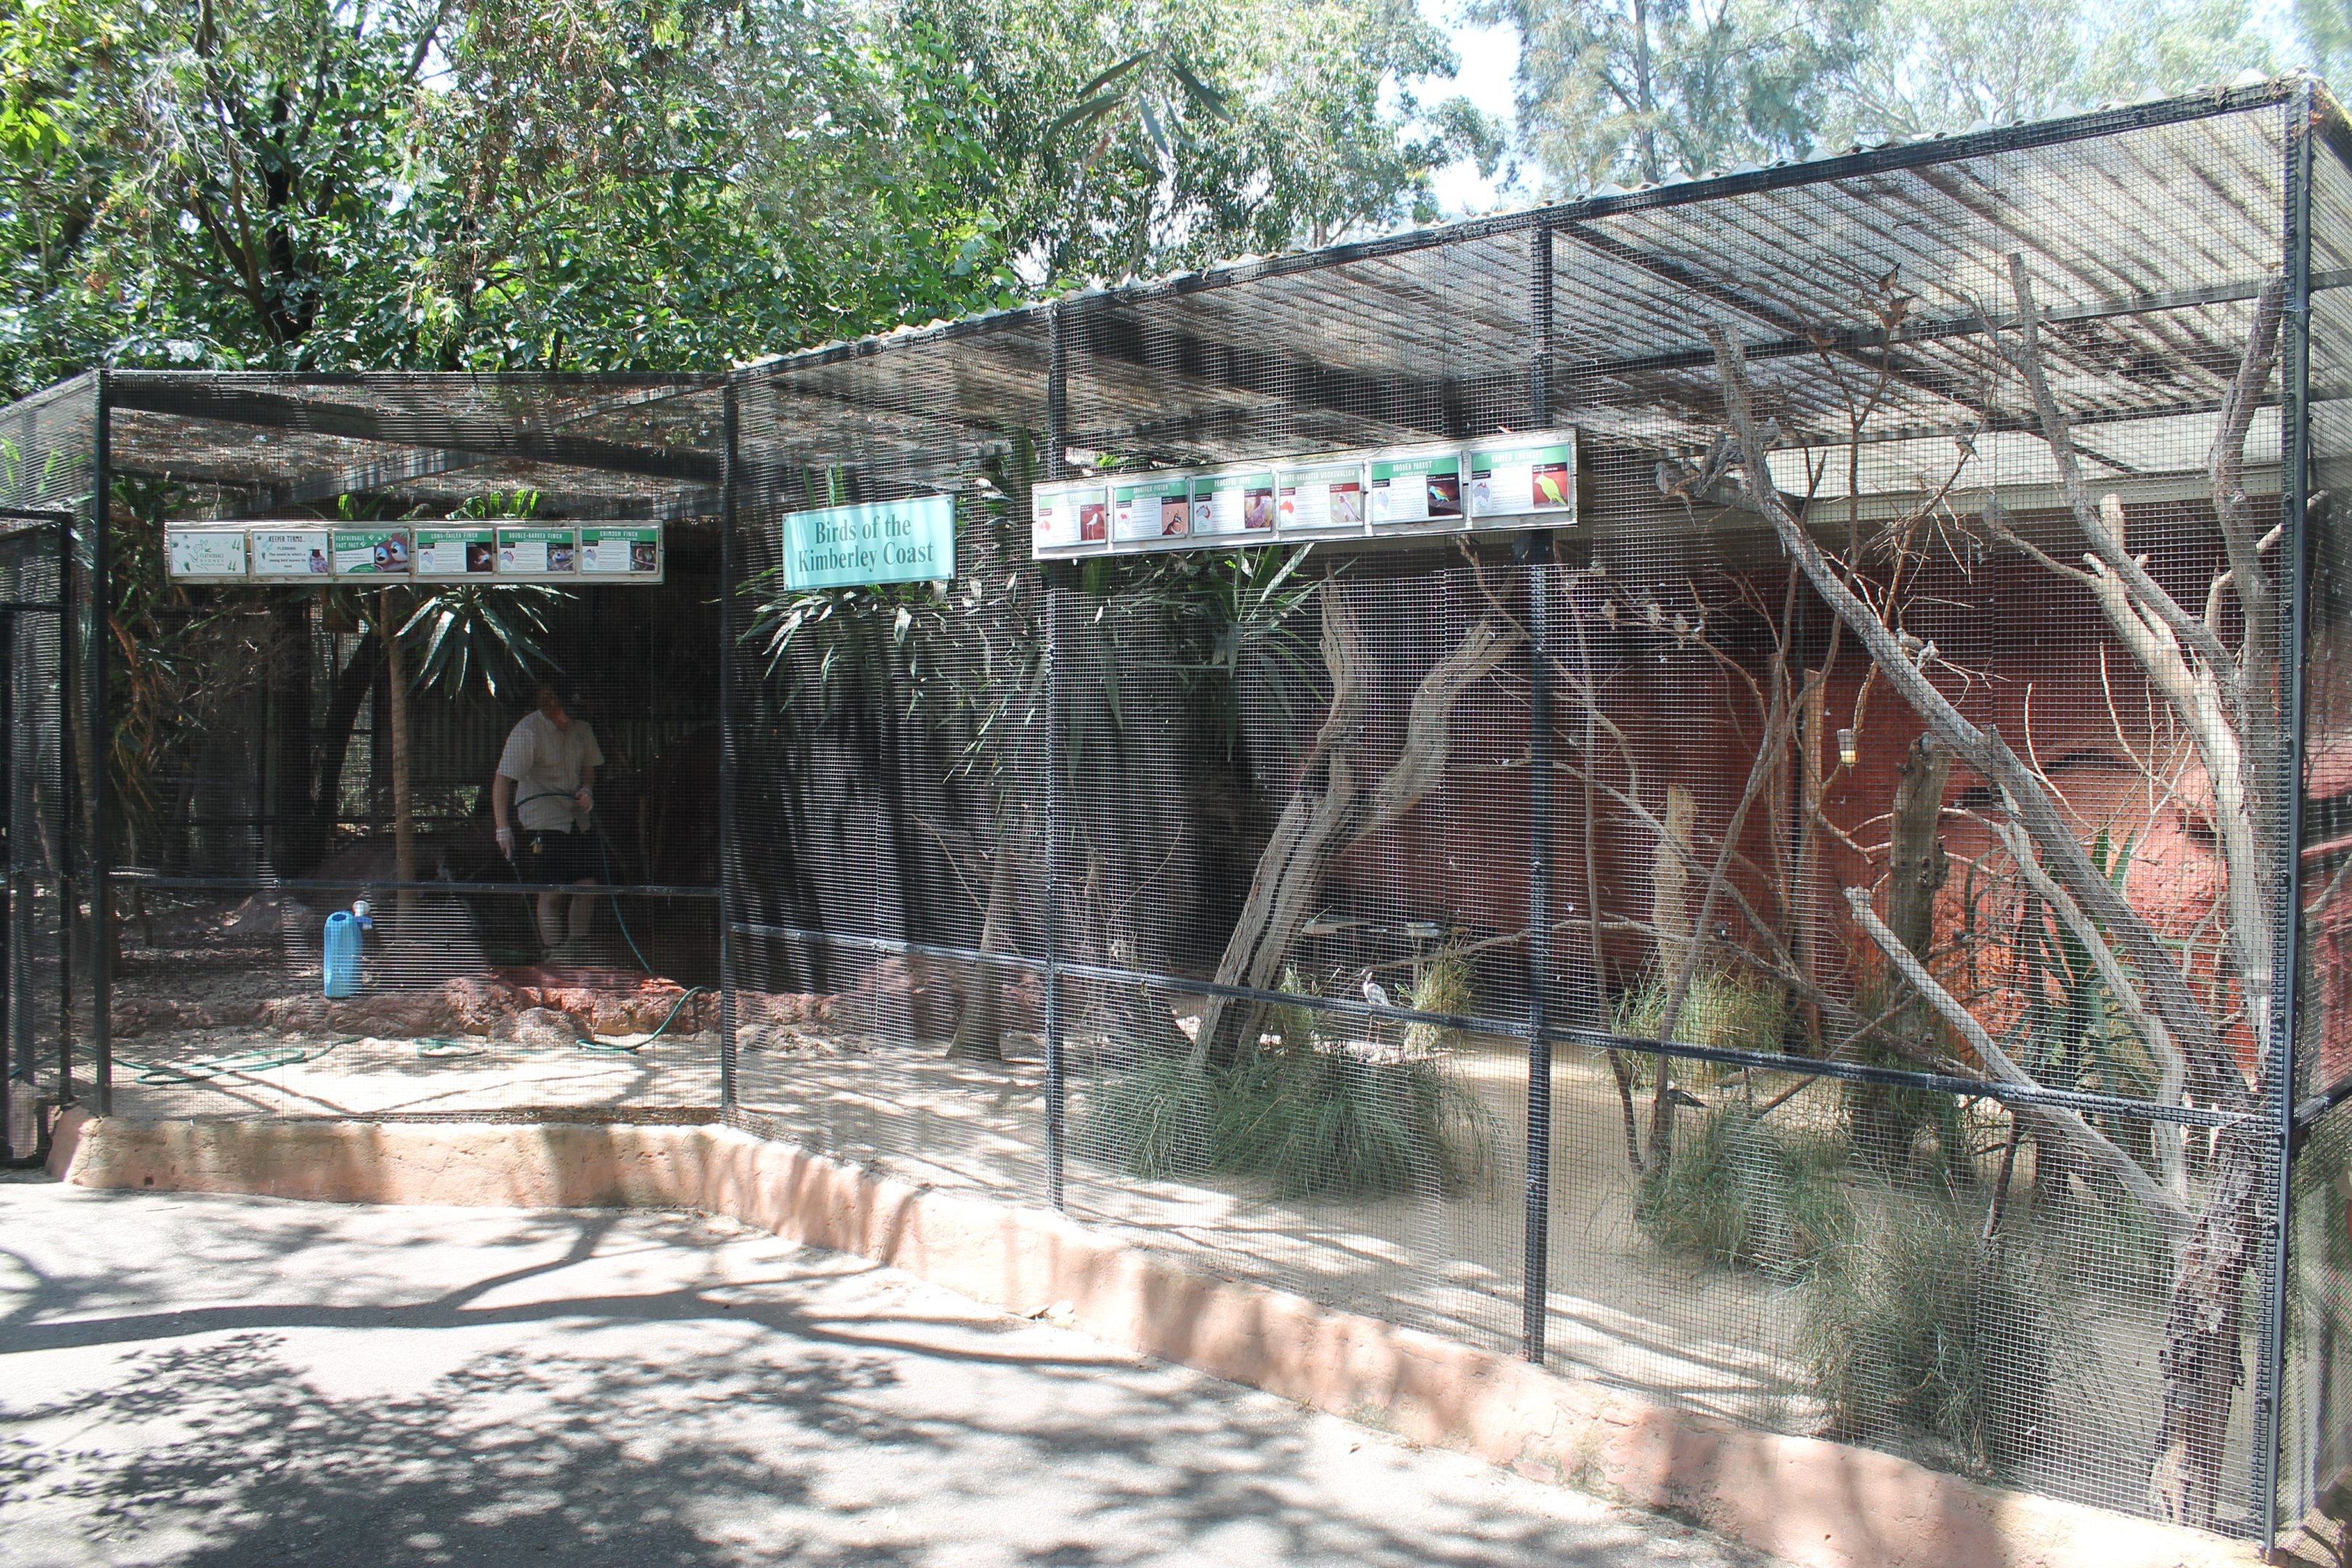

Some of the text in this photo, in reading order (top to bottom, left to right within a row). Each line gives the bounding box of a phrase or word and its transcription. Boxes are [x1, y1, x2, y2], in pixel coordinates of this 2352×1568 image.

[1413, 461, 1432, 470] PARROT
[814, 514, 911, 544] Birds of the
[798, 541, 934, 573] Kimberley Coast
